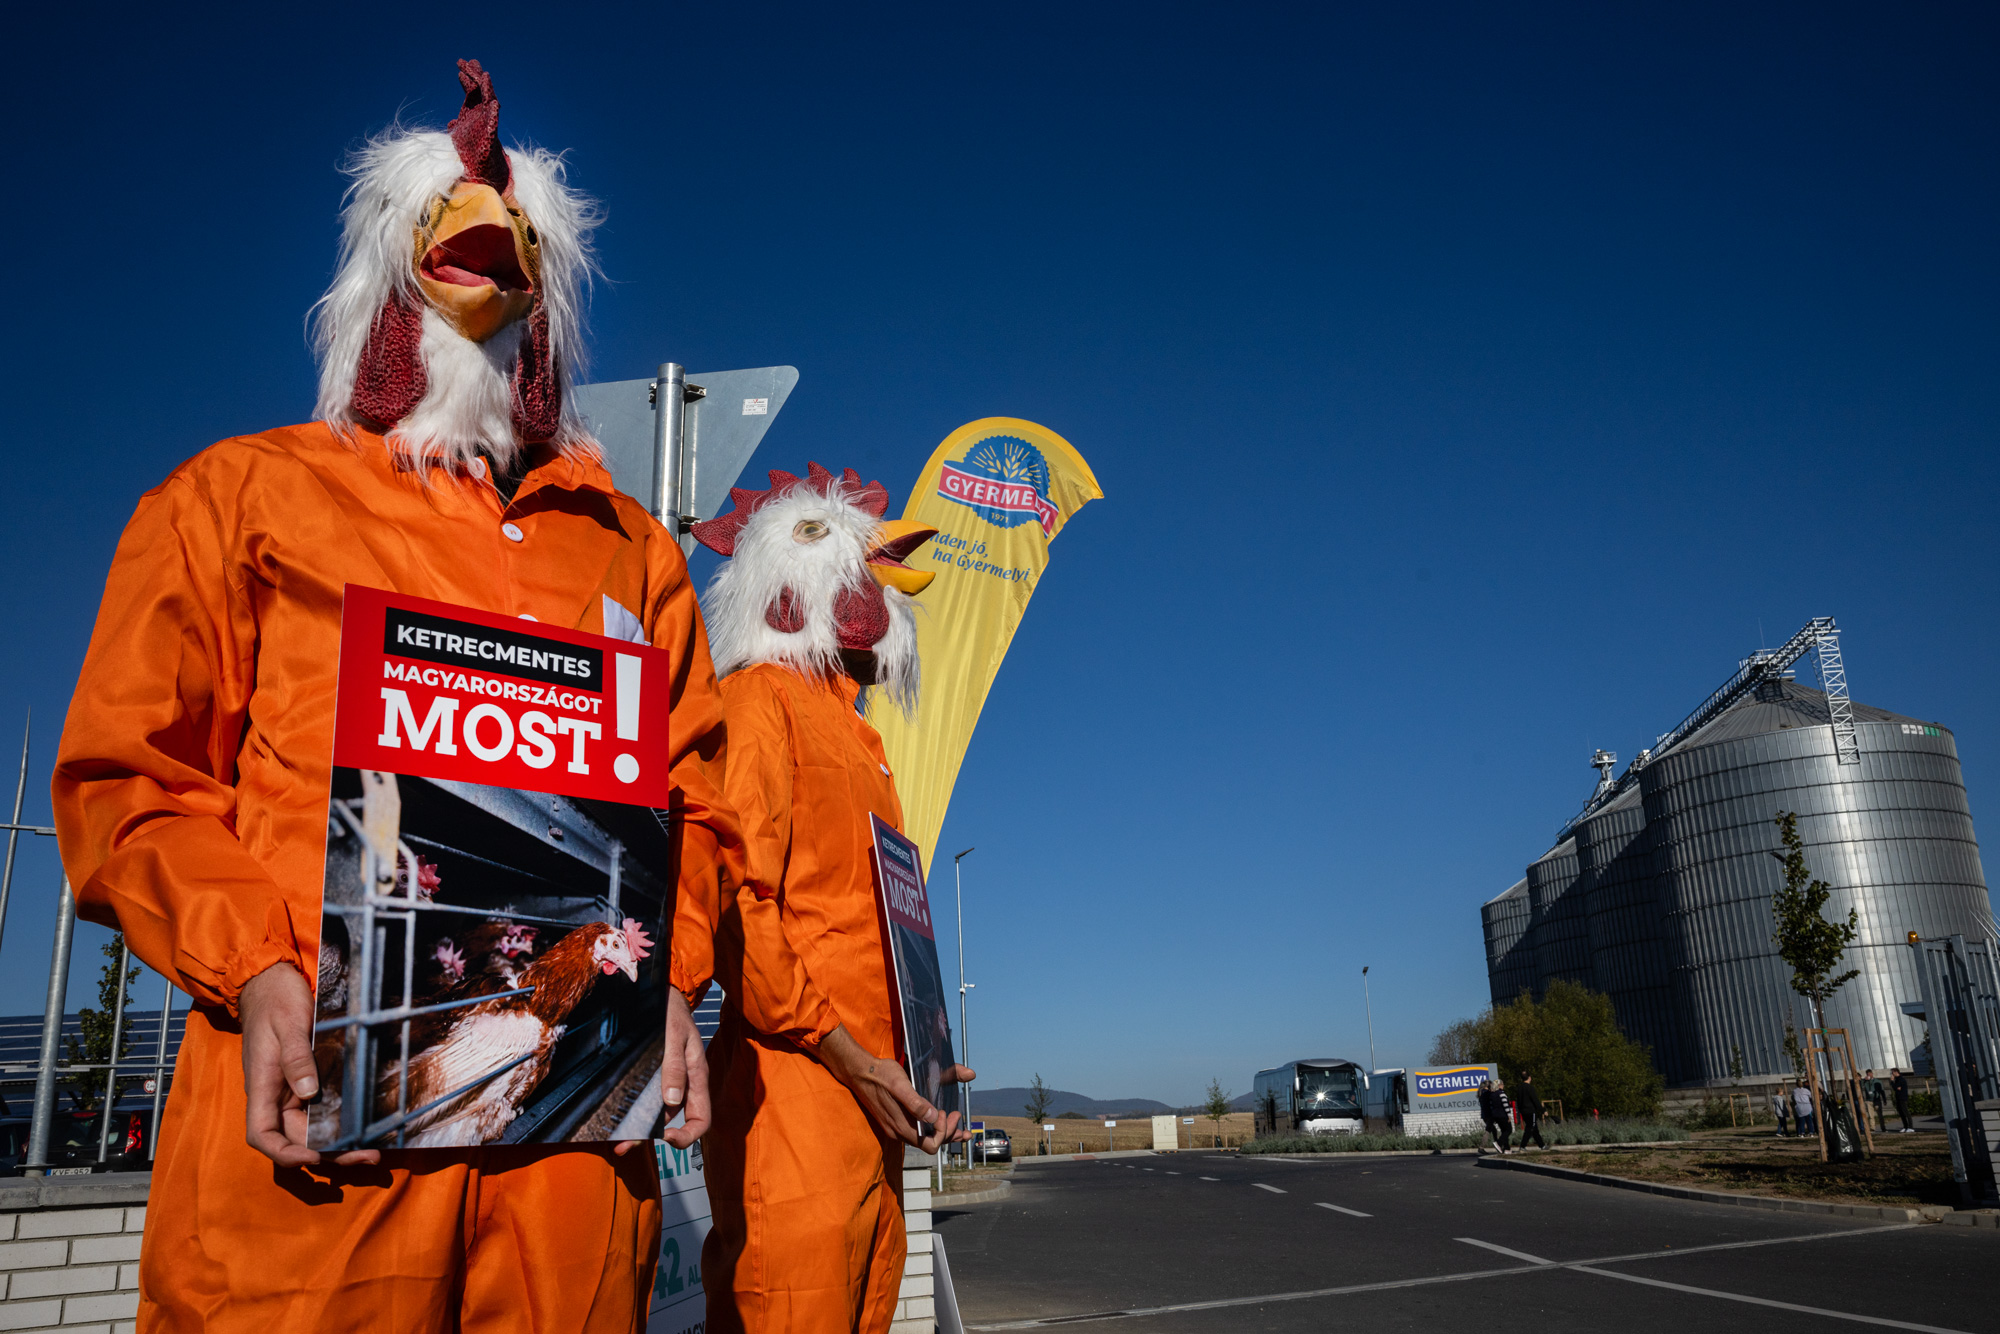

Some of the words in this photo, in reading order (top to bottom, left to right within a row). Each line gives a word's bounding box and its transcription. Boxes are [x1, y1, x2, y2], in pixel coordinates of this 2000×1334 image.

[991, 512, 1009, 523] 1971
[929, 533, 967, 551] nden
[967, 540, 988, 558] jó,
[932, 547, 953, 564] ha
[956, 554, 1031, 583] Gyermelyi
[397, 624, 591, 678] KETRECMENTES
[383, 661, 602, 714] MAGYARORSZÁGOT
[688, 1264, 702, 1287] AL
